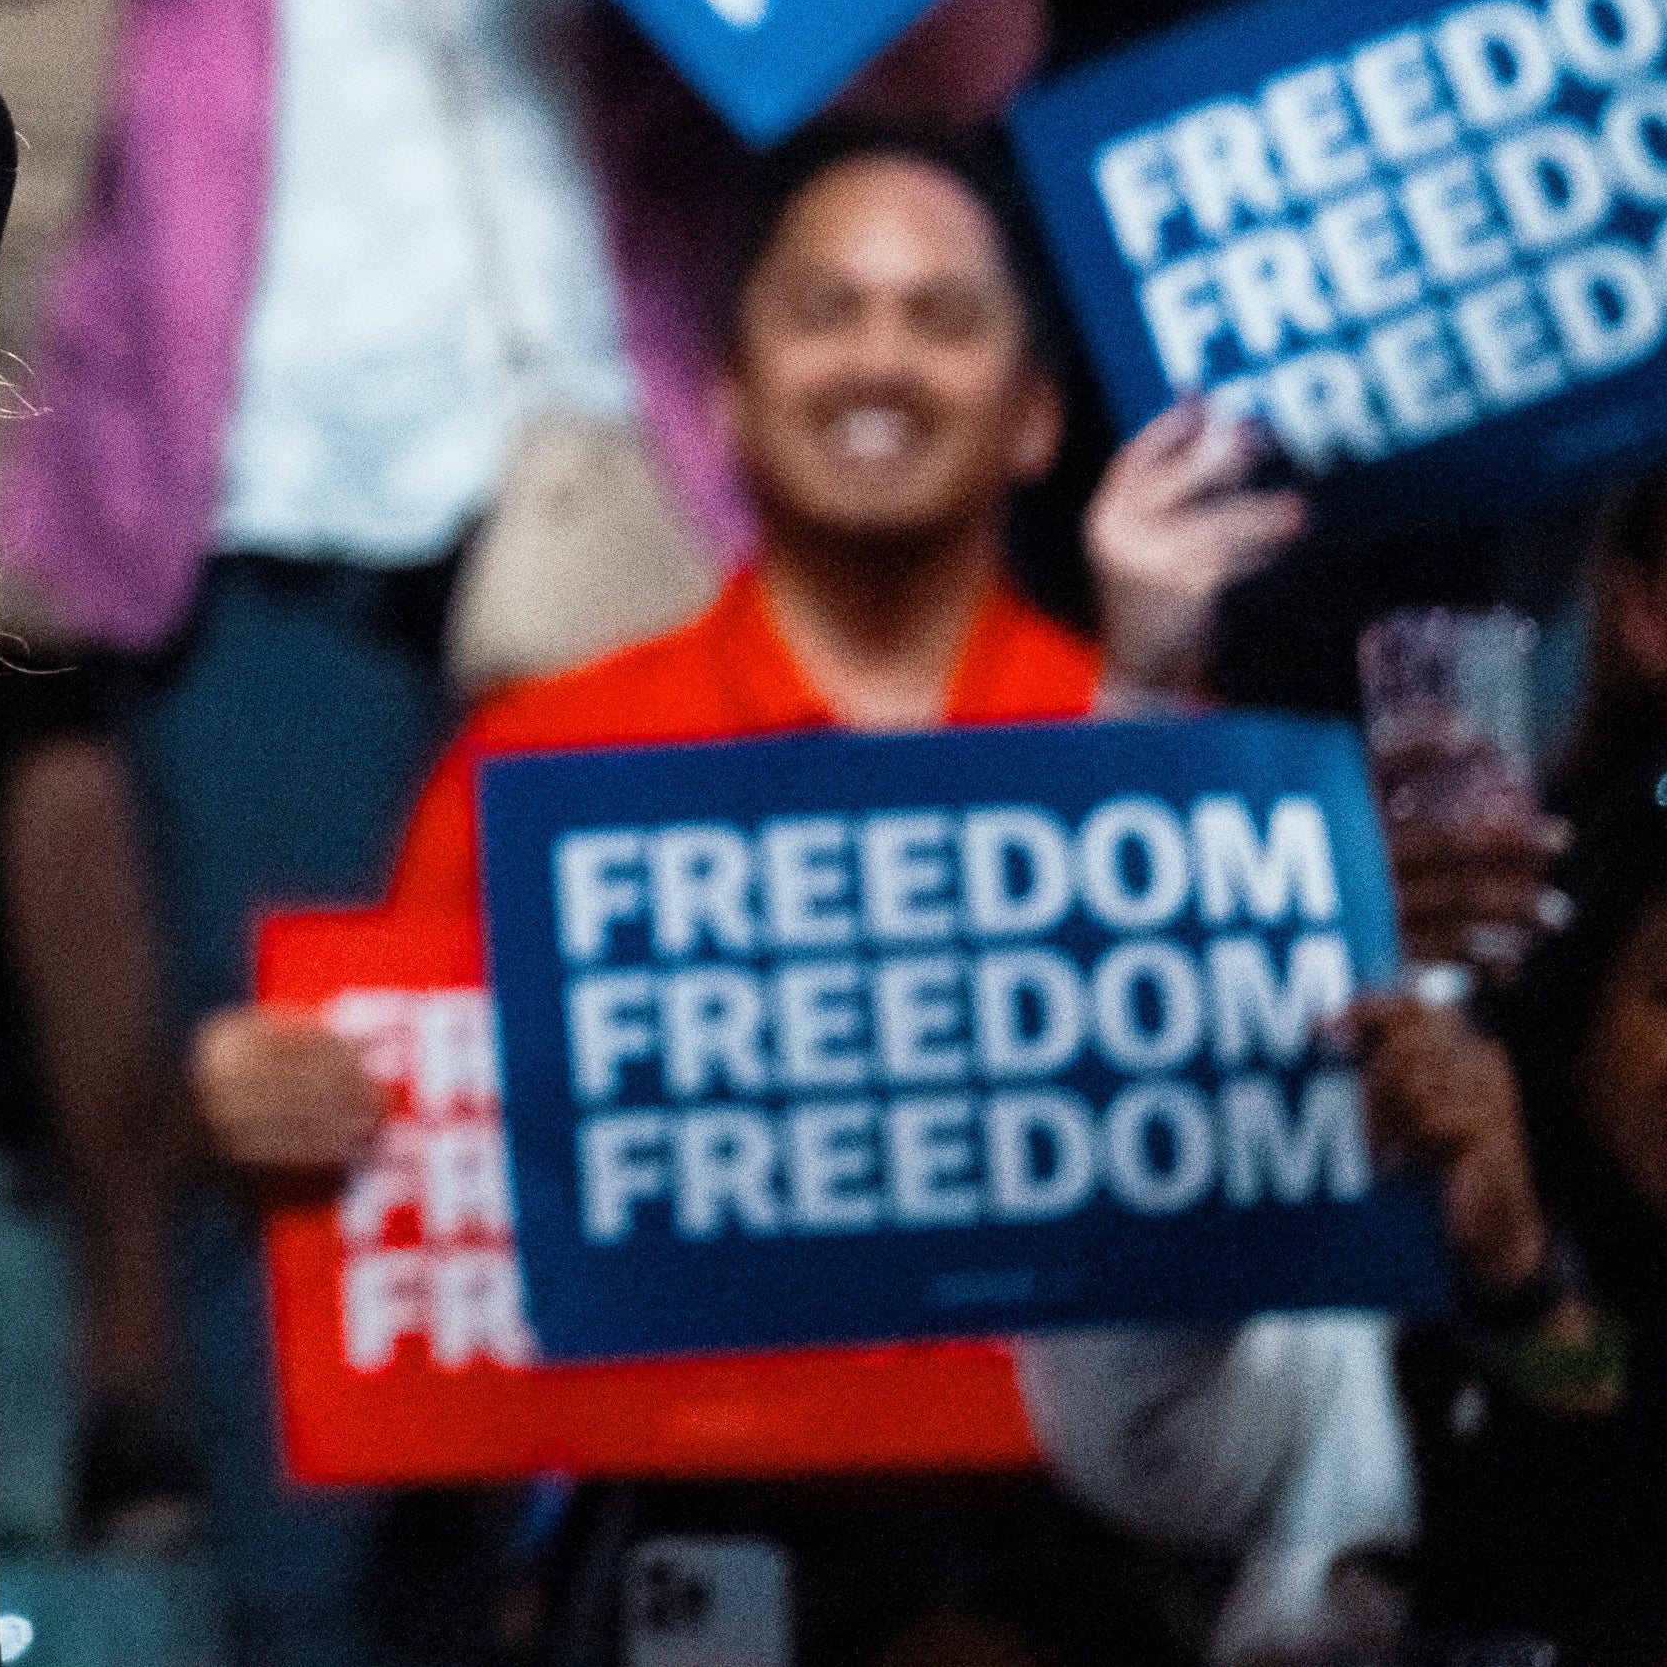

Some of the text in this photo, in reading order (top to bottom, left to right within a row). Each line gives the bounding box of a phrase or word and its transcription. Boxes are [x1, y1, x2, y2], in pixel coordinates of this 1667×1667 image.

[552, 793, 1339, 963] FREEDOM
[565, 934, 1353, 1103] FREEDOM
[577, 1071, 1373, 1245] FREEDOM
